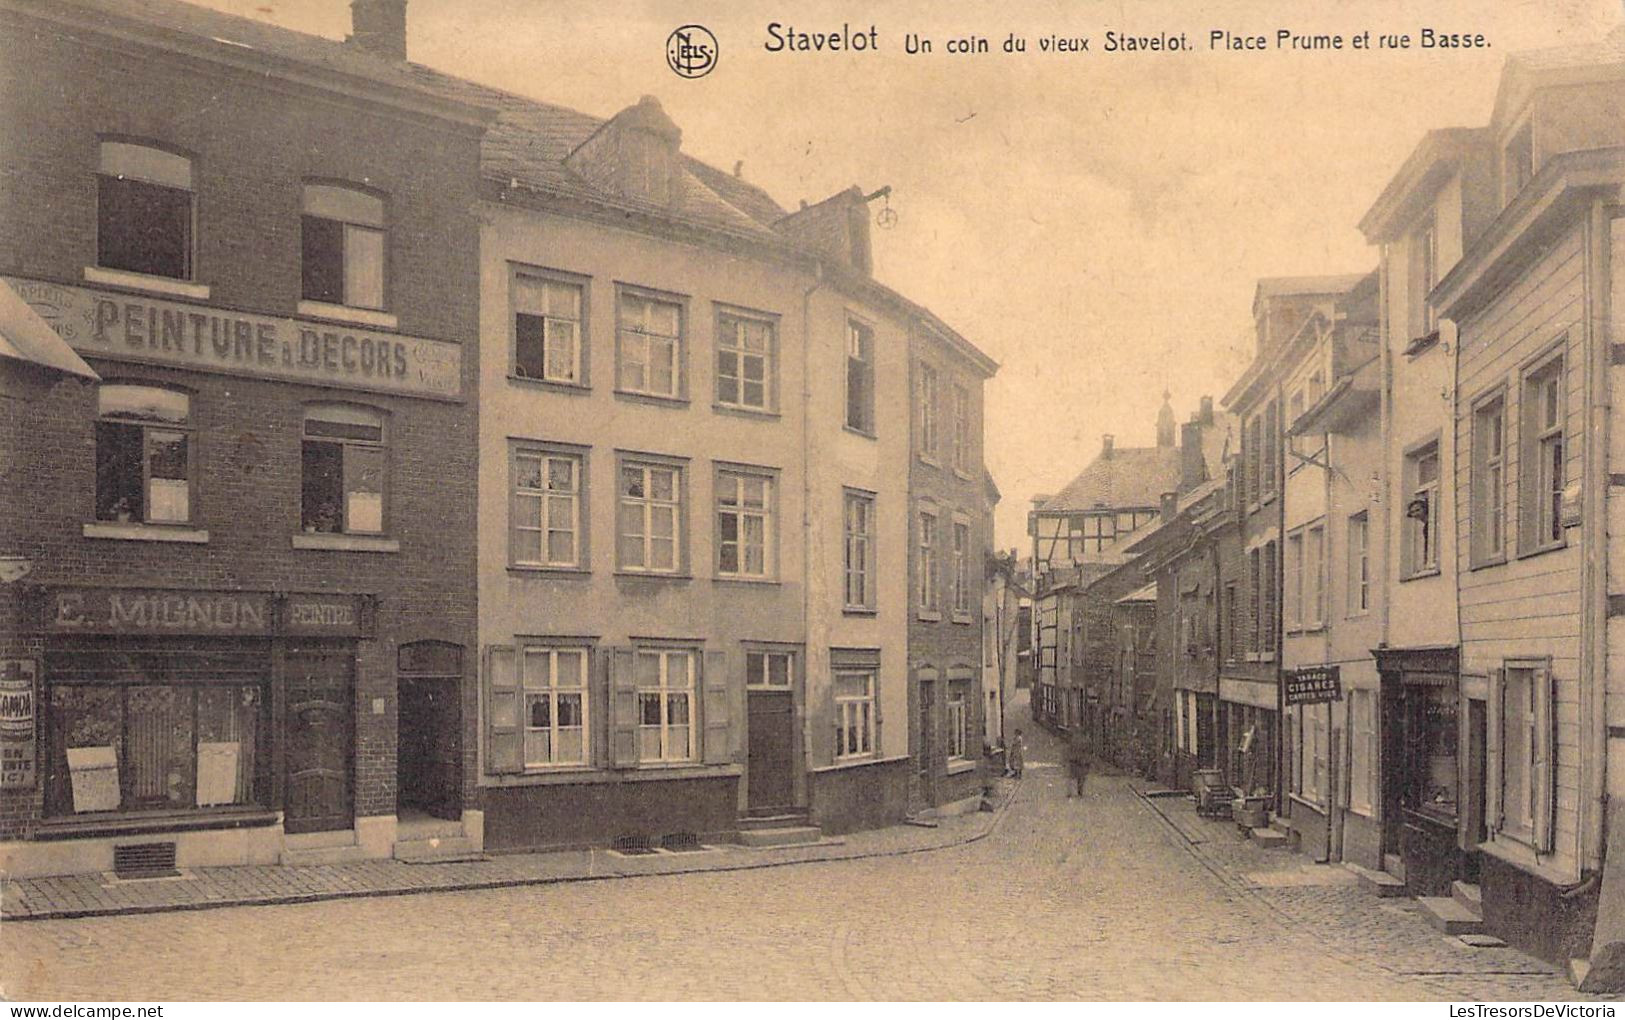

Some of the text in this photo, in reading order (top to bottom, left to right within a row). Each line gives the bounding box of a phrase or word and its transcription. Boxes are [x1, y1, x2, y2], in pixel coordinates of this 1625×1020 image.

[84, 296, 277, 364] PEINTURE
[297, 326, 407, 377] DECORS
[54, 592, 264, 629] E. MIGNON
[290, 603, 355, 626] PEINTRE
